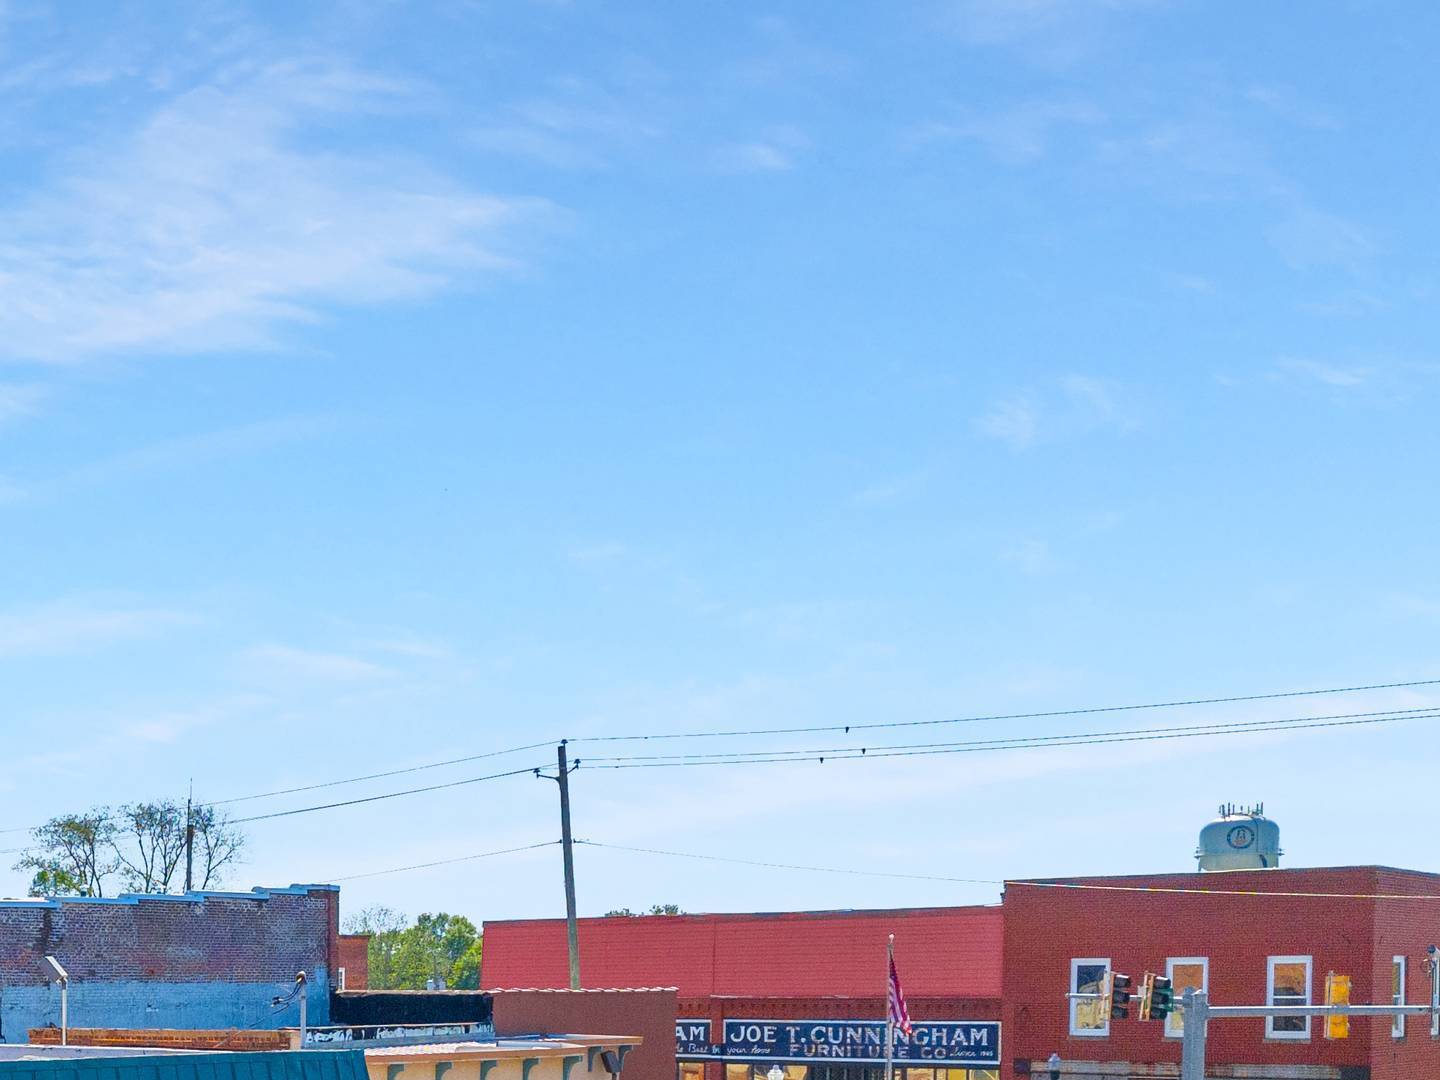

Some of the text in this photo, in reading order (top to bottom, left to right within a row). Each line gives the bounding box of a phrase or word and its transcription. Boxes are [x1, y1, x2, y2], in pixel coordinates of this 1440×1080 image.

[730, 1026, 988, 1046] JOE T. CUNNINGHAM
[790, 1044, 947, 1059] FURNITURE CO
